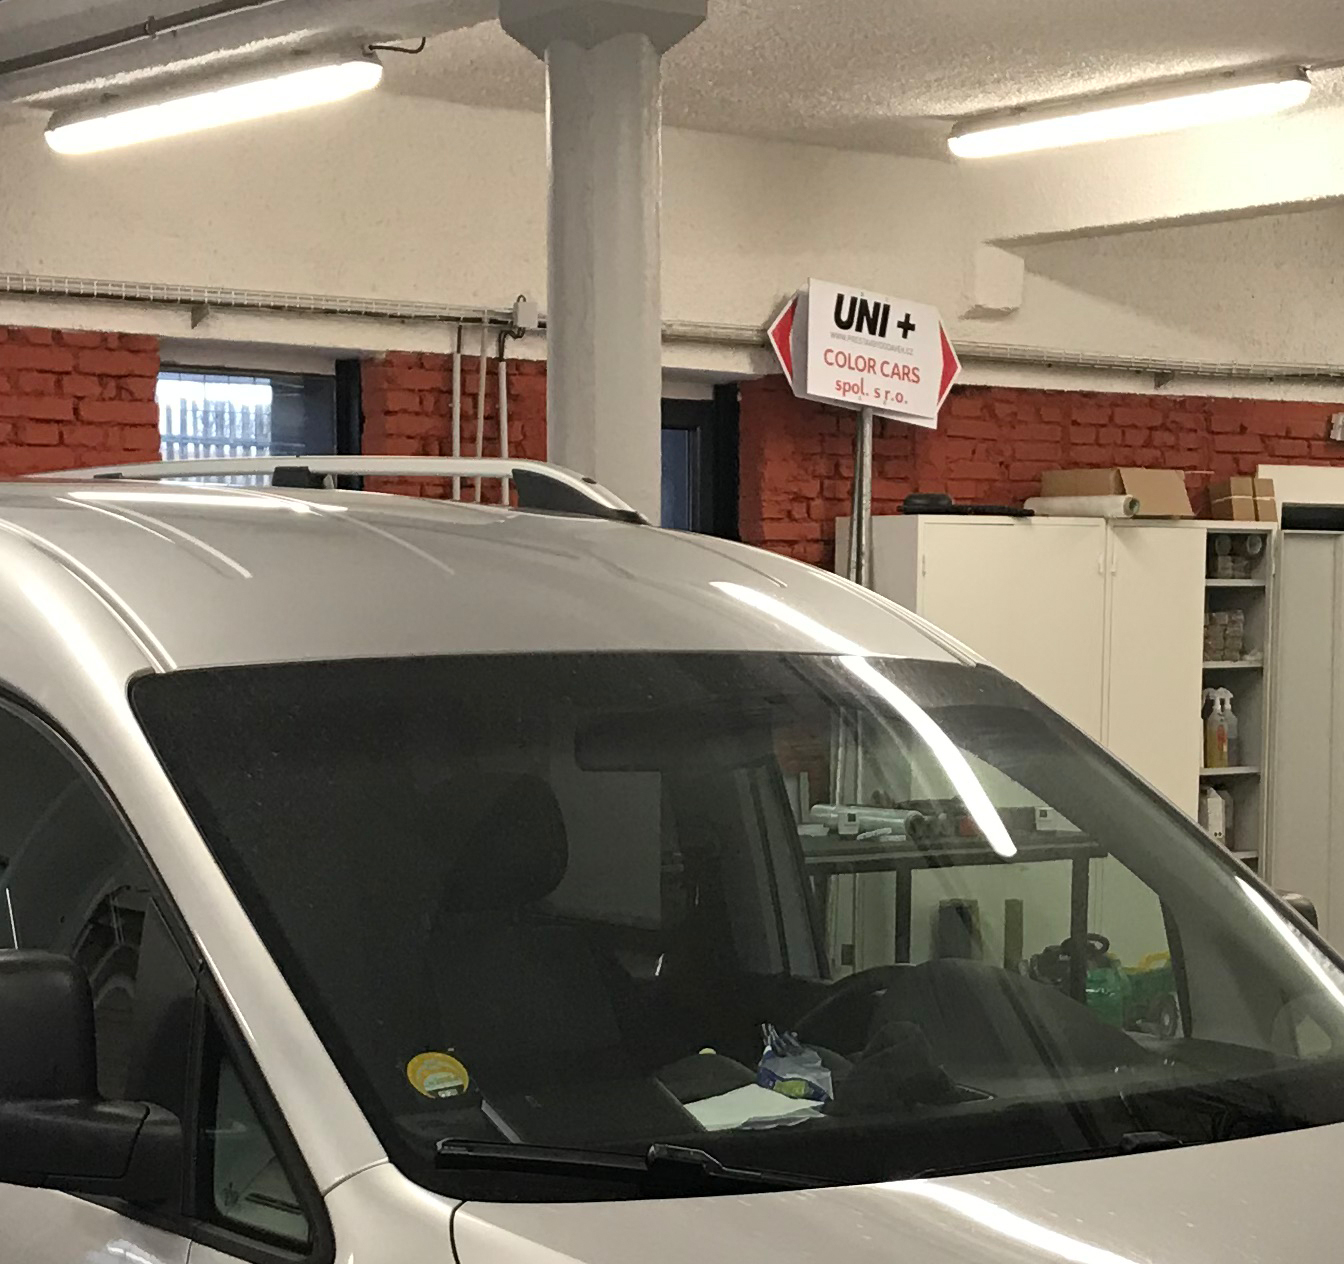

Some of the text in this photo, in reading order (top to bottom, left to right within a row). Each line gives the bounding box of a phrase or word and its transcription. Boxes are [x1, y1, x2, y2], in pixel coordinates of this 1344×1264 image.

[834, 293, 891, 338] UNI
[823, 348, 921, 384] COLOR CARS
[835, 377, 908, 404] spol. s r.o.
